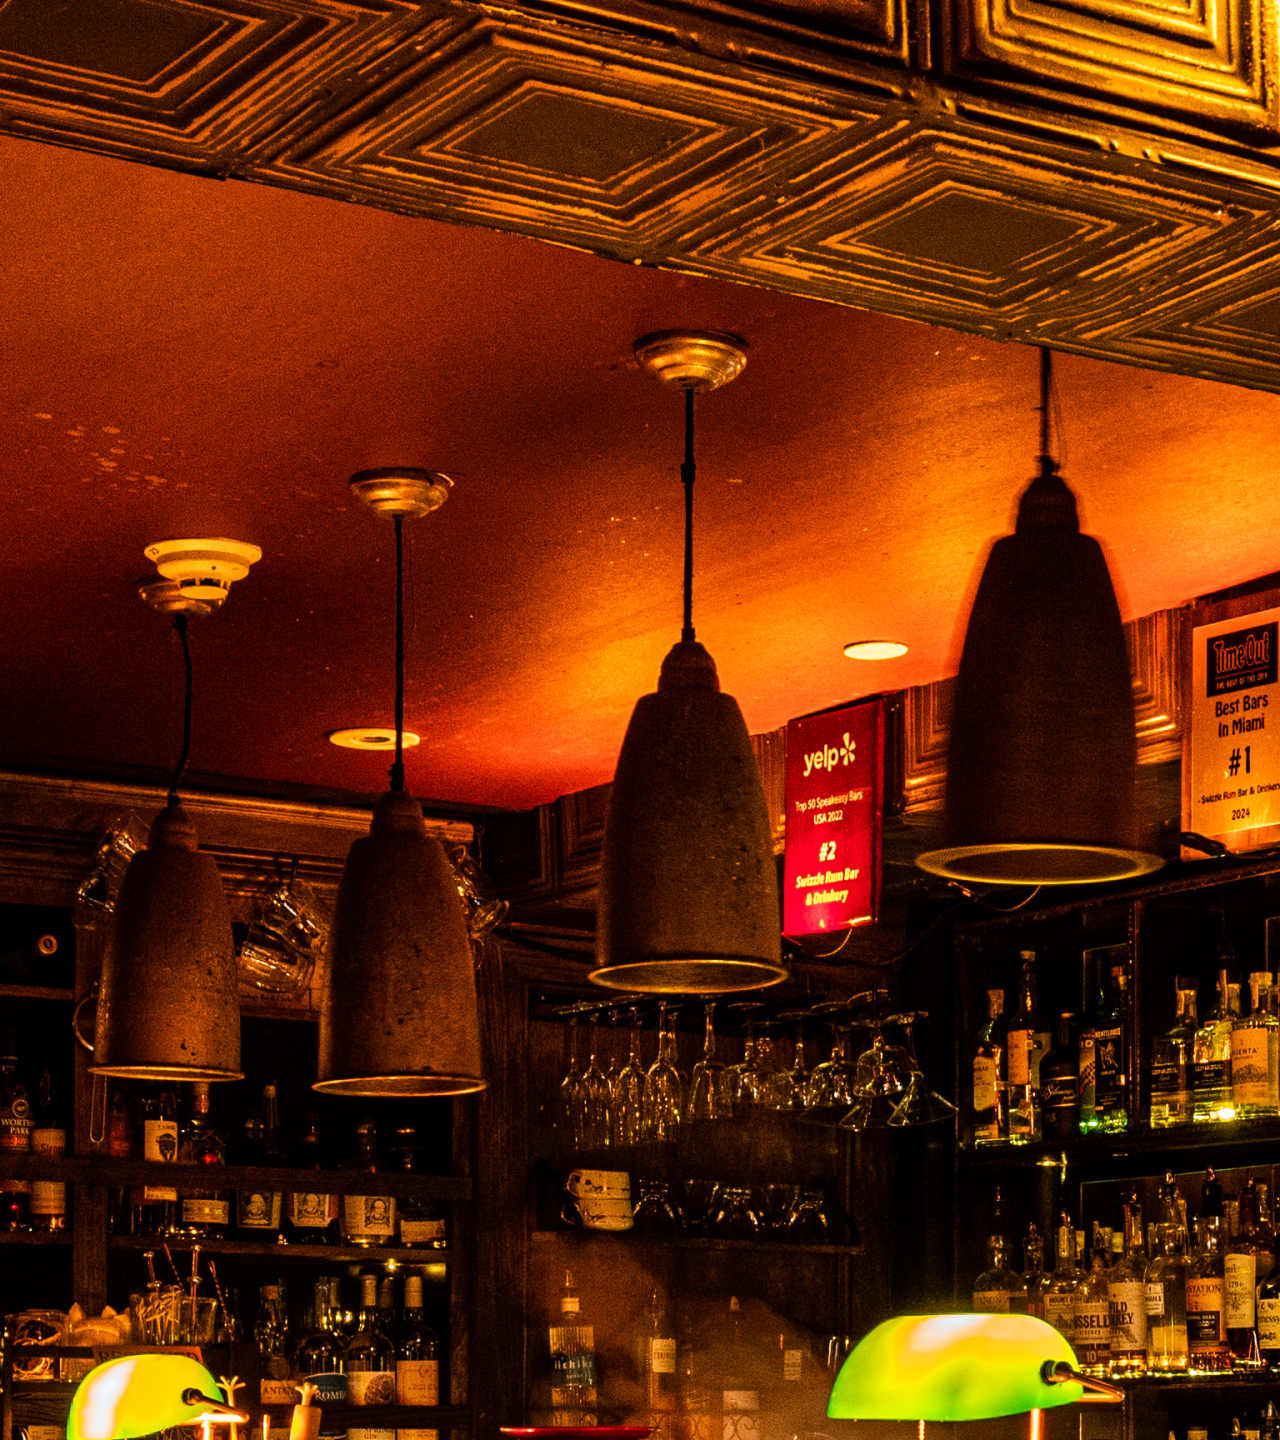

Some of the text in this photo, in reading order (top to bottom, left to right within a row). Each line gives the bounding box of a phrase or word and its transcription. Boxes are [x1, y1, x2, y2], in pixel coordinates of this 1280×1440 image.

[1215, 694, 1269, 718] Best Bars
[1218, 713, 1265, 738] In Miami
[803, 744, 839, 777] yelp
[1228, 745, 1251, 777] #1
[795, 790, 864, 814] Top 50 Speakeasy Bars
[1237, 787, 1248, 797] Bar
[813, 810, 843, 824] USA 2022
[1231, 808, 1250, 820] 2024
[819, 841, 837, 862] #2
[795, 867, 860, 889] Swizzle Rum Bar
[805, 889, 849, 906] & Drinkery
